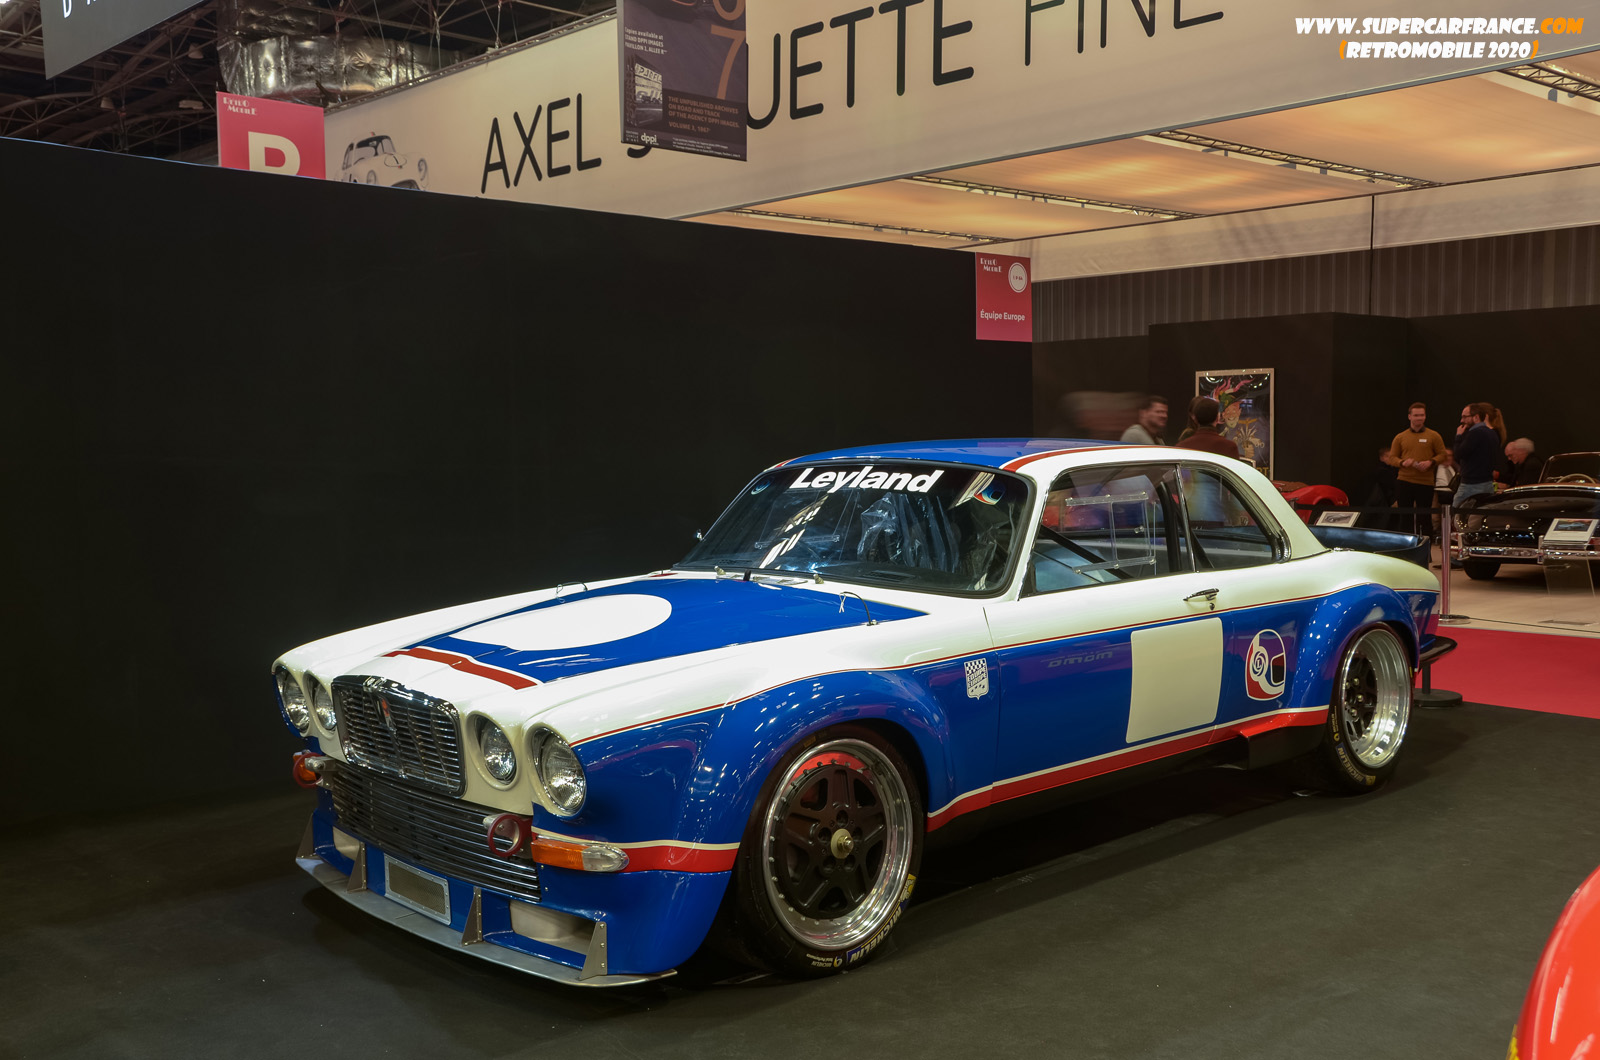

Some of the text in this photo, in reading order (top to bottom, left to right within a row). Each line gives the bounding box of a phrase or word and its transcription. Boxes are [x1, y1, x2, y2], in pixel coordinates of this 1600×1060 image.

[481, 92, 602, 194] AXEL
[1025, 0, 1224, 66] FIN
[980, 308, 1026, 322] Équipe Europe
[789, 465, 945, 494] Leyland
[850, 907, 902, 963] MICHELIN
